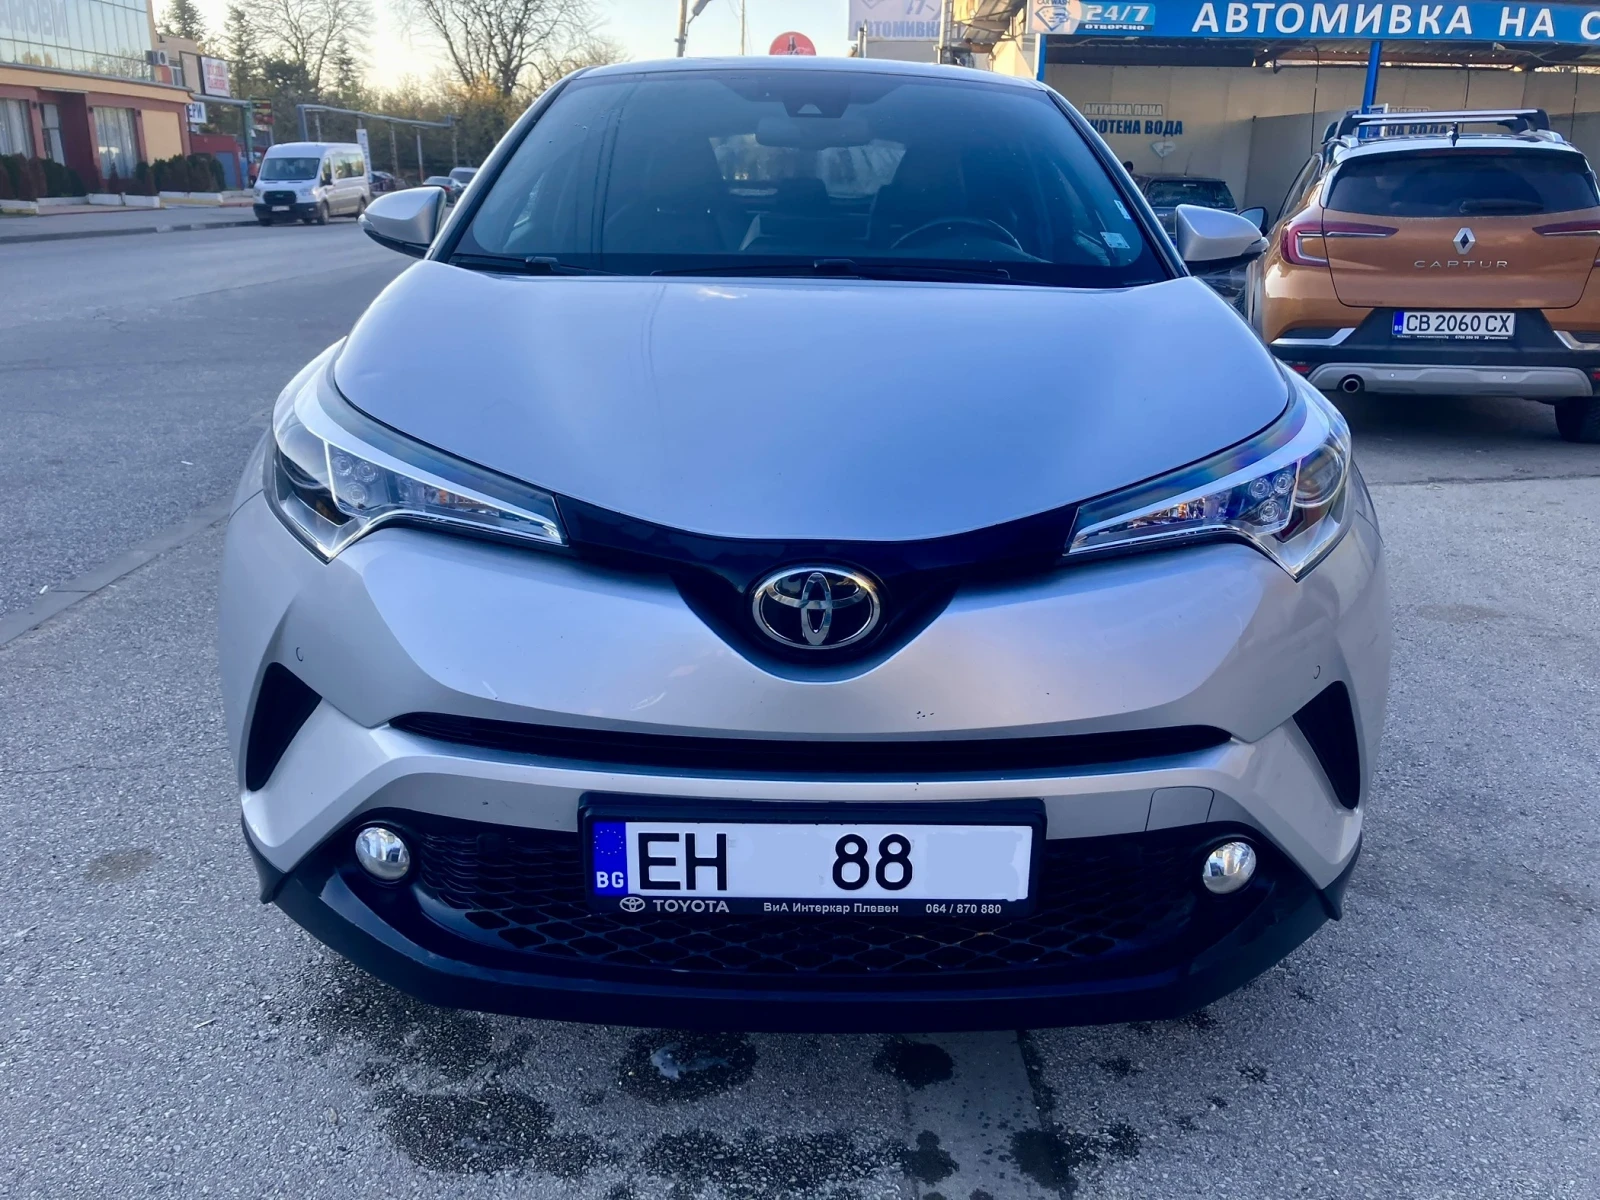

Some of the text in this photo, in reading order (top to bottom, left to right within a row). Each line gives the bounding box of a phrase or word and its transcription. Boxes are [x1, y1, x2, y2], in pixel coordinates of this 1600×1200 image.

[1086, 5, 1150, 22] 24/7
[1191, 3, 1473, 35] АВТОМИВКА
[1499, 7, 1555, 37] НА
[1133, 105, 1162, 116] ПЯНА
[1144, 120, 1183, 136] ВОДА
[1414, 260, 1508, 268] CAPTUR
[1406, 314, 1511, 332] CB 2060 CX
[638, 833, 913, 891] EH 88
[596, 871, 624, 888] BG
[653, 900, 729, 913] TOYOTA
[763, 902, 899, 914] ВиА Интеркар Плевен
[925, 904, 947, 914] 064
[956, 904, 977, 914] 870
[980, 904, 1002, 914] 880
